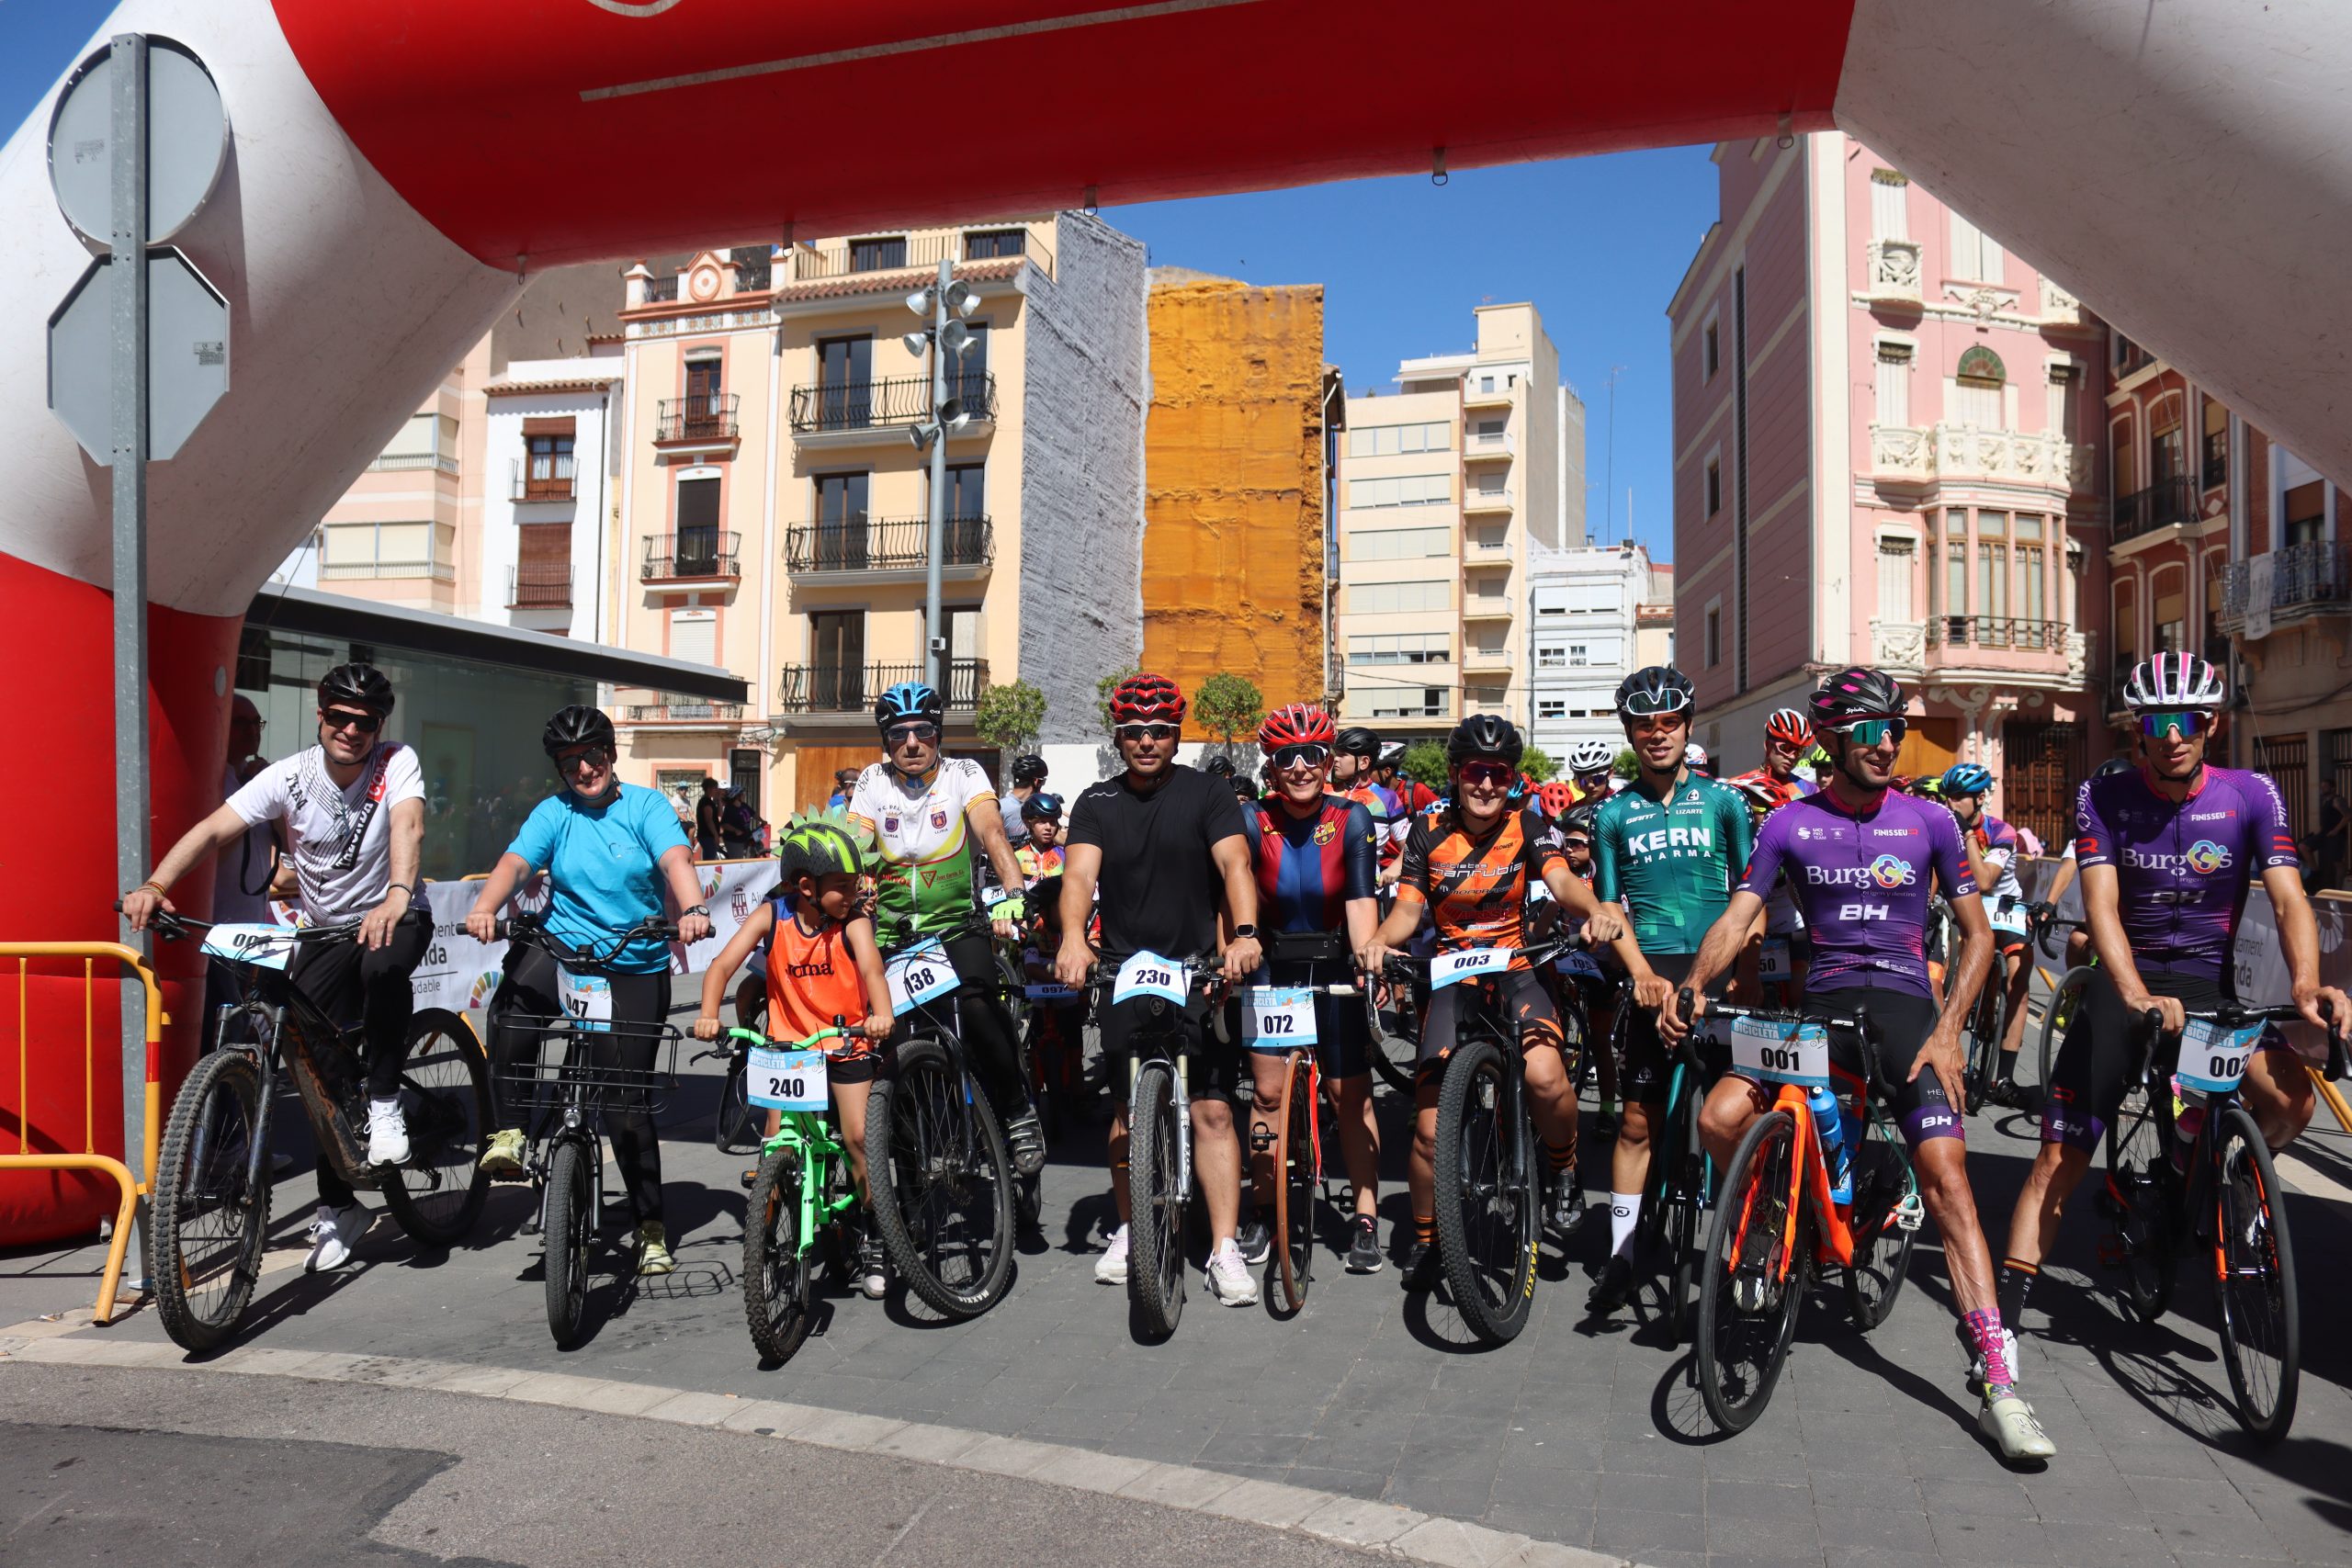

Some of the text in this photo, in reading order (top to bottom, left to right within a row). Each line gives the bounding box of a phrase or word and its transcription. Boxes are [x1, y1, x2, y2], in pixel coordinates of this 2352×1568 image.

[286, 773, 309, 810] TEAM
[1625, 813, 1657, 825] GIANT
[1628, 828, 1711, 856] KERN
[1633, 849, 1712, 866] PHARMA
[990, 889, 1003, 899] 237
[2151, 890, 2207, 903] BH
[1838, 904, 1889, 920] BH
[1453, 954, 1491, 969] 003
[904, 967, 935, 994] 138
[1135, 969, 1171, 987] 230
[566, 993, 588, 1019] 047
[1263, 1014, 1295, 1034] 072
[1734, 1021, 1780, 1039] BICICLETA
[2186, 1025, 2235, 1047] BICICLETA
[749, 1055, 786, 1069] BICICLETA
[1761, 1047, 1800, 1071] 001
[2210, 1054, 2250, 1077] 002
[769, 1077, 805, 1098] 240
[1922, 1116, 1952, 1129] BH
[2052, 1119, 2084, 1136] BH
[1524, 1240, 1538, 1300] MAXXIS
[957, 1289, 989, 1303] MAXXIS
